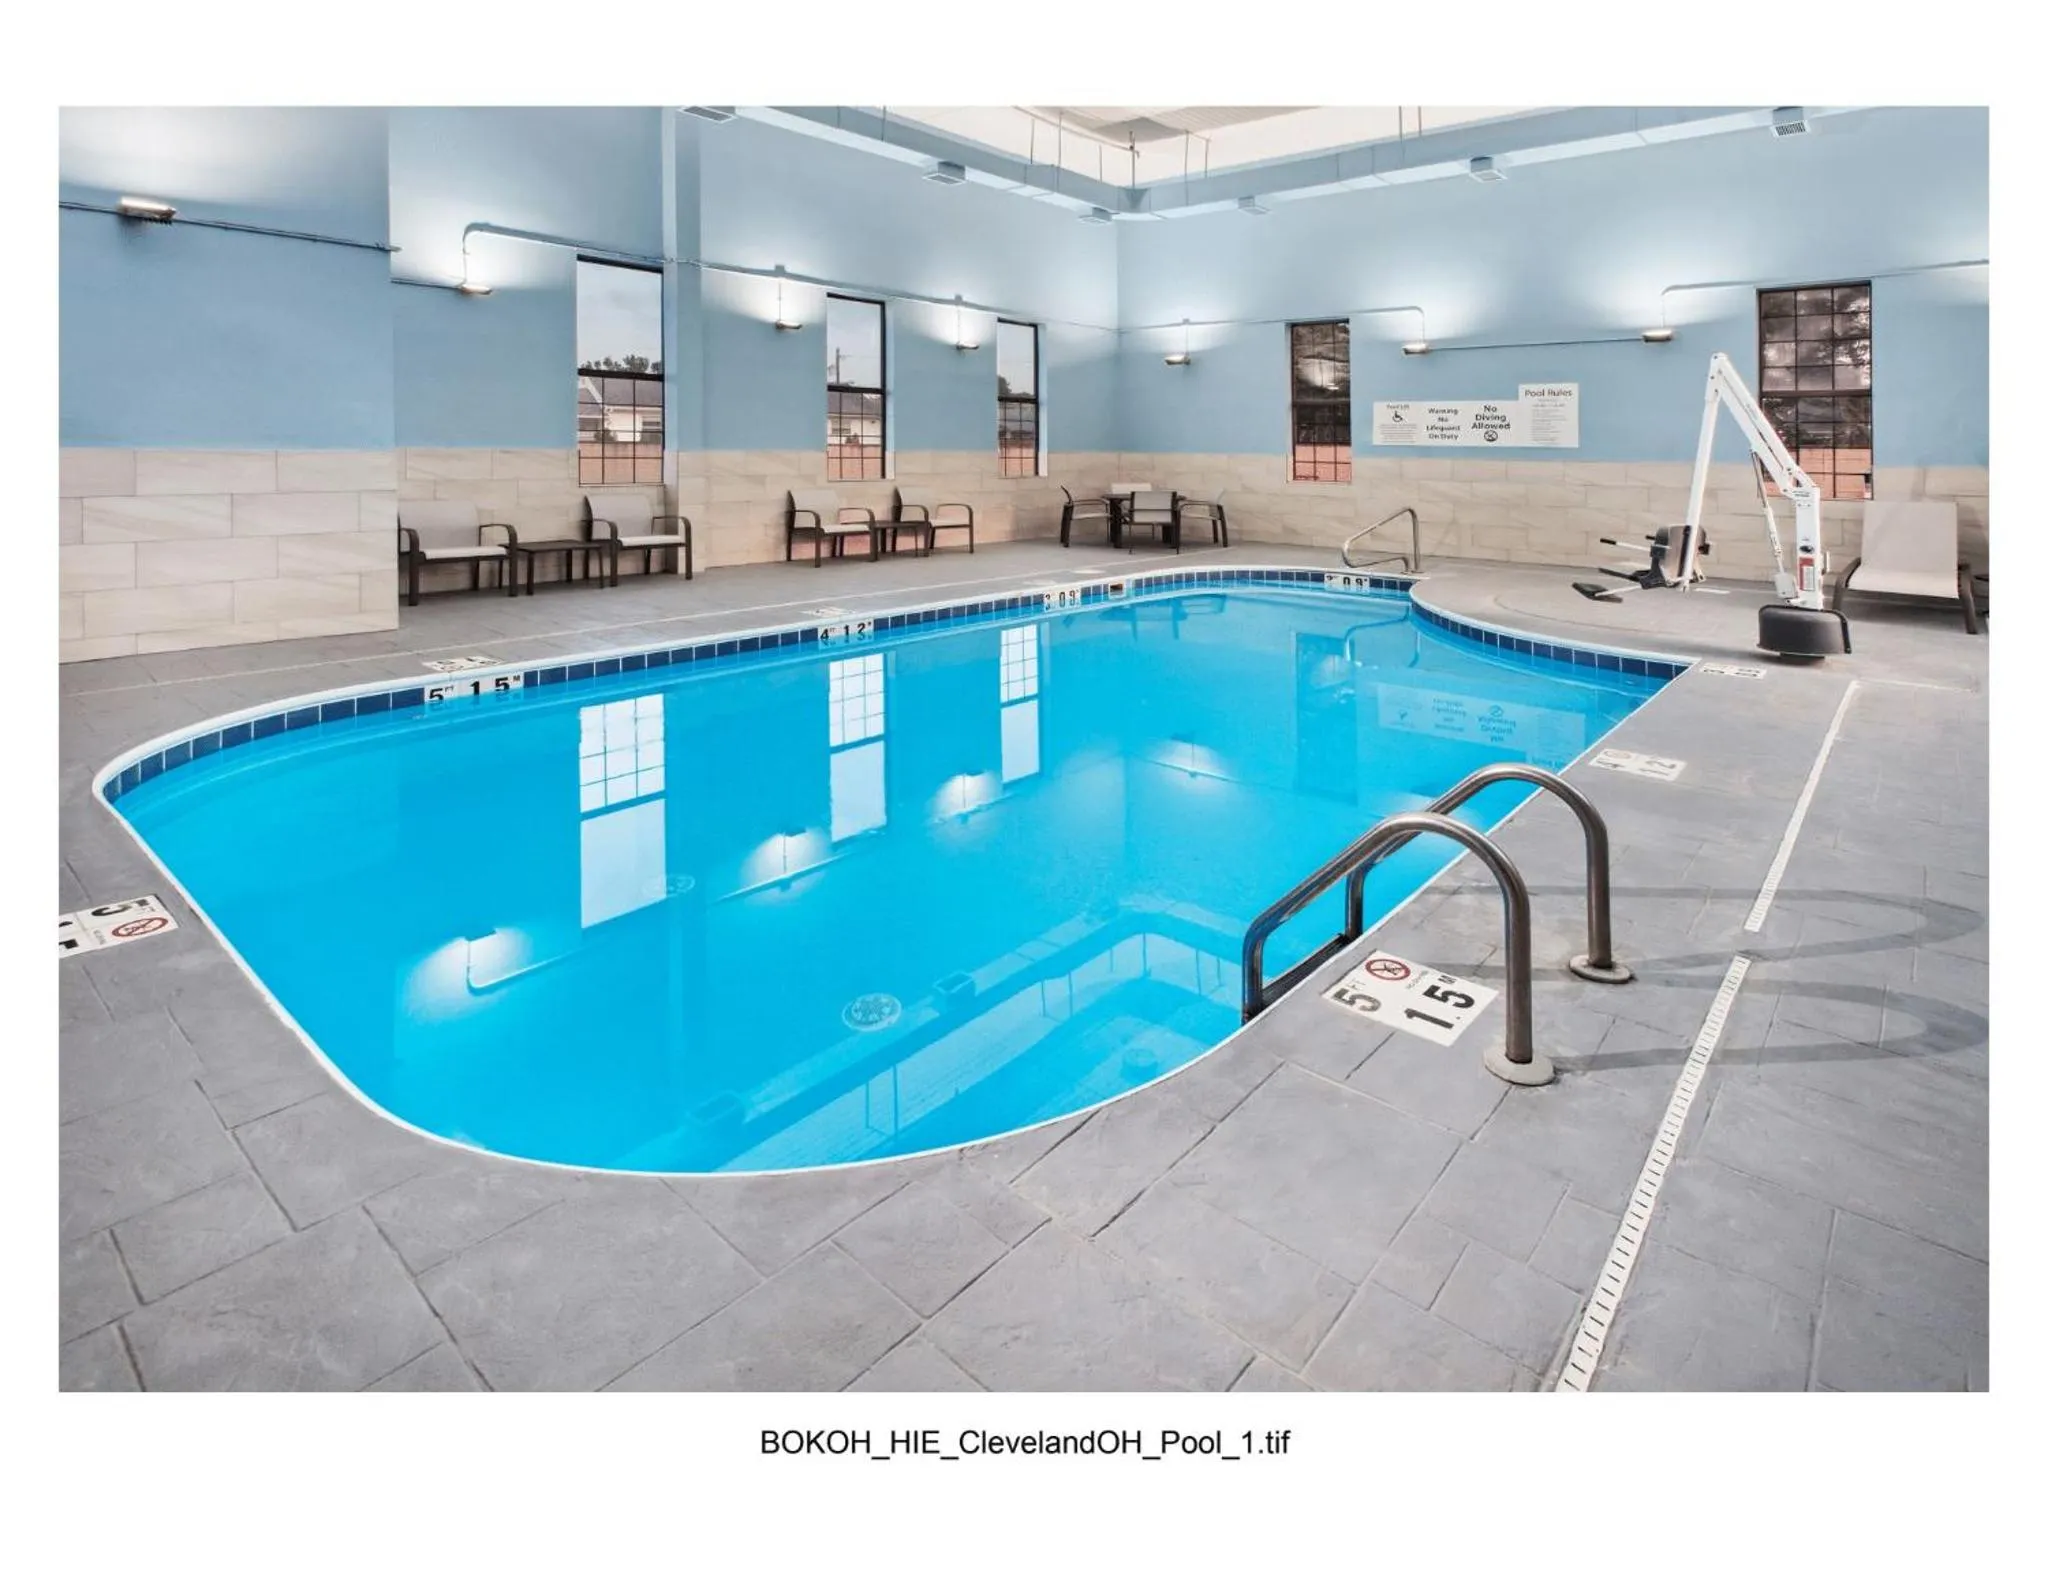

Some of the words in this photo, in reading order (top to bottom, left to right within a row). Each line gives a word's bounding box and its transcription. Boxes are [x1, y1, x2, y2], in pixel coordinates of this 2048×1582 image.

[1525, 389, 1545, 397] Pool
[1548, 389, 1573, 397] Rules
[1475, 413, 1507, 422] Diving
[1471, 422, 1511, 430] Allowed
